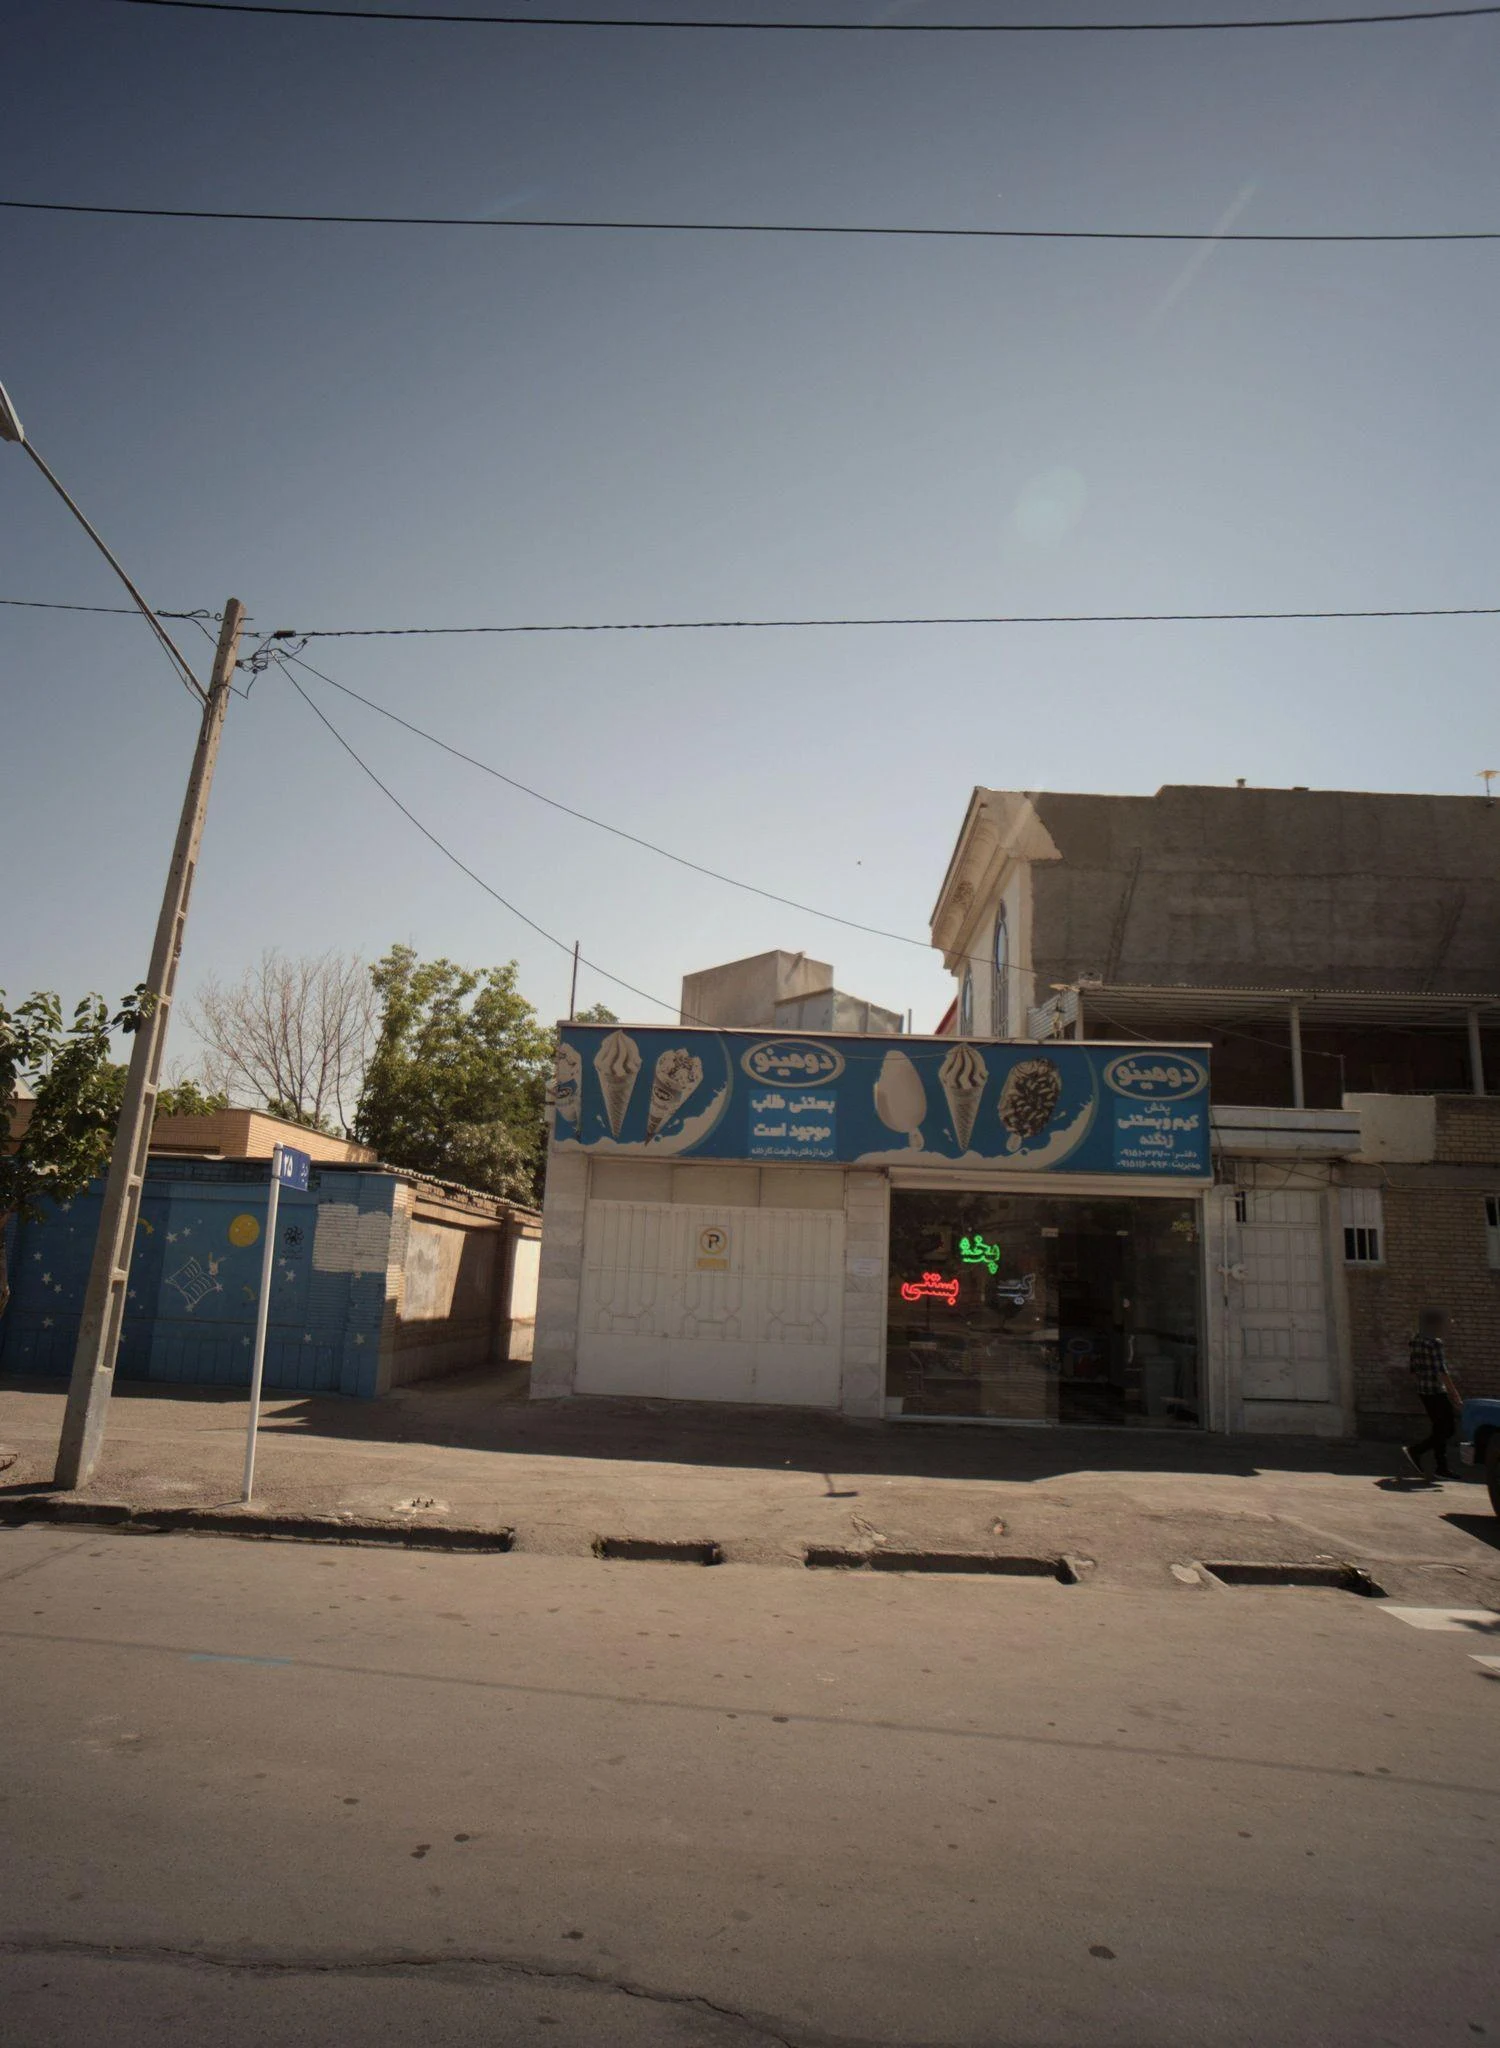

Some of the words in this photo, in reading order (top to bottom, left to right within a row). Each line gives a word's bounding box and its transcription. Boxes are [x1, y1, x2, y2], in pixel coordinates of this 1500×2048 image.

[754, 1049, 834, 1076] دومینو
[1116, 1061, 1199, 1090] دومینو
[789, 1096, 836, 1114] بستنی
[1144, 1102, 1171, 1115] پخش
[753, 1122, 787, 1137] است
[1117, 1114, 1162, 1129] بستنی
[1162, 1117, 1172, 1131] و
[1172, 1114, 1199, 1131] کیم
[789, 1125, 831, 1142] موجود
[1139, 1132, 1174, 1148] زنگنه
[901, 1272, 960, 1306] بستنی
